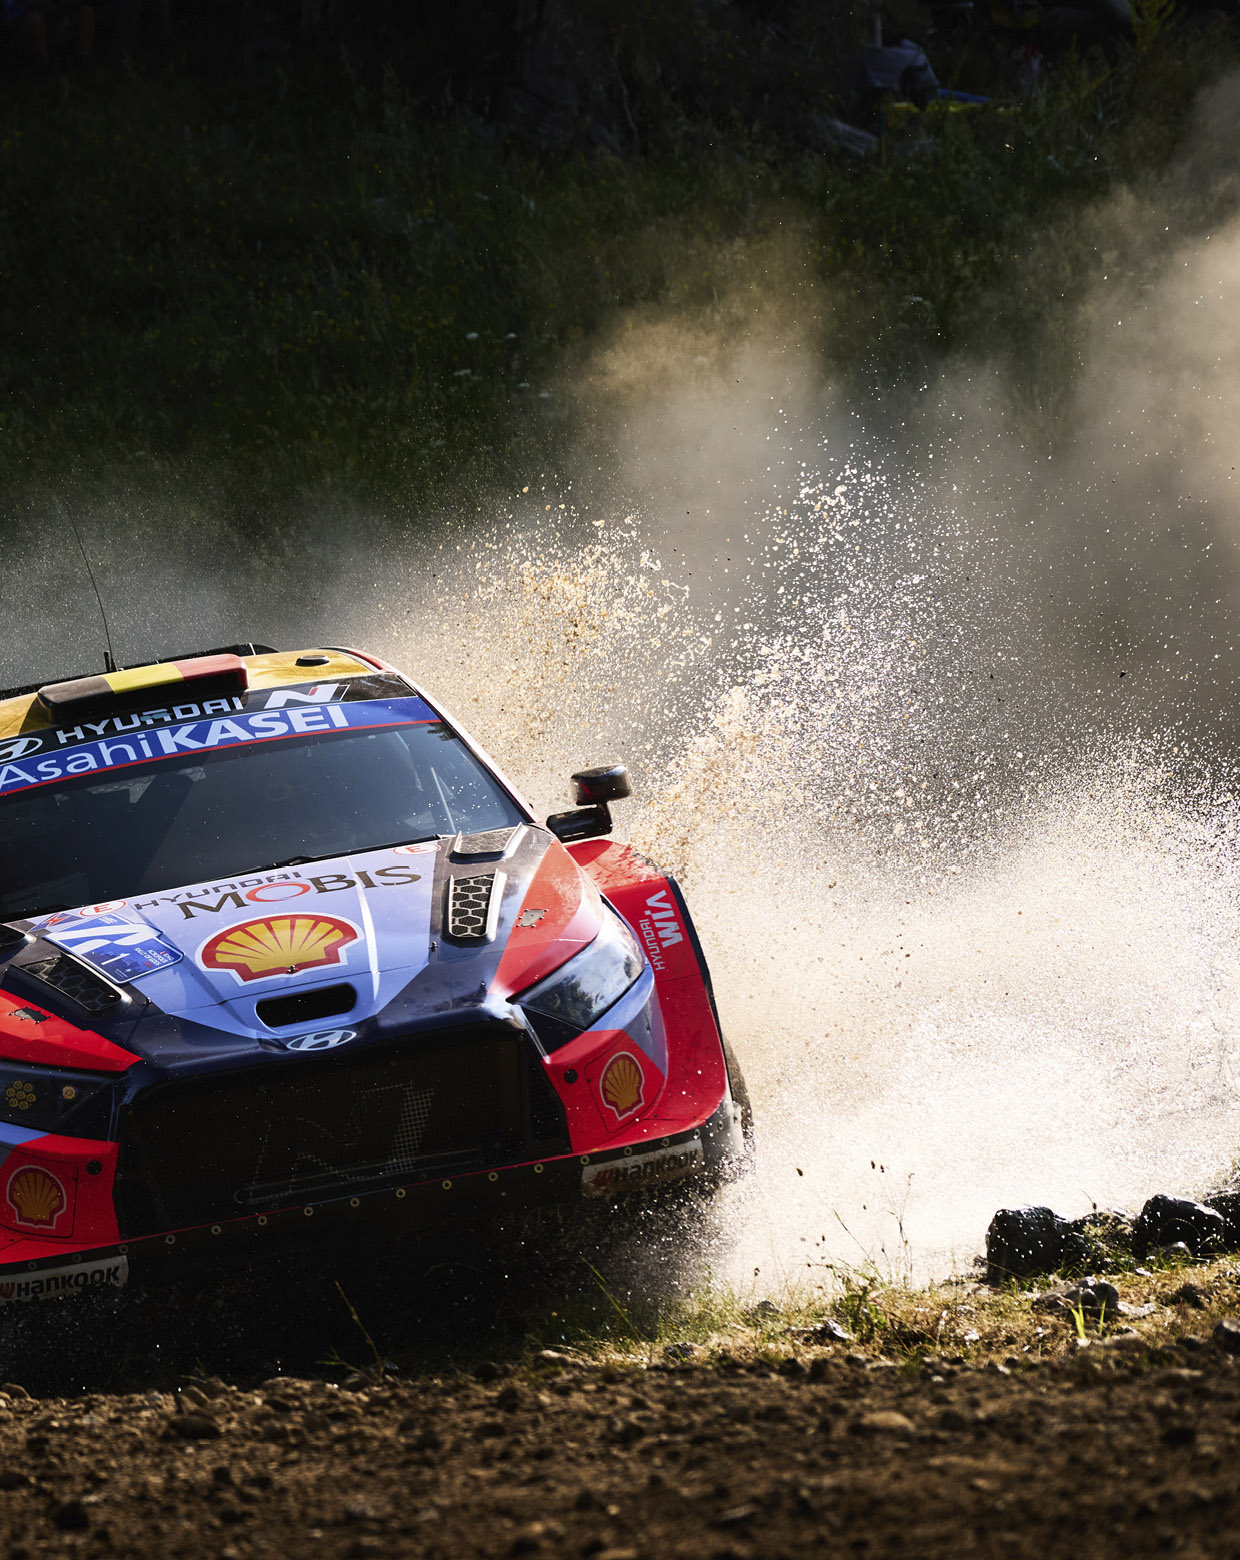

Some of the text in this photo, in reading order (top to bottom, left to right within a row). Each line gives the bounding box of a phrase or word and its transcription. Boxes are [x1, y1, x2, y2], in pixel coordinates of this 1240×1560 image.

[56, 697, 244, 744] HYUNDAI
[135, 871, 302, 910] HYUNDAI
[176, 865, 422, 920] MOBIS
[639, 919, 665, 970] HYUNDAI
